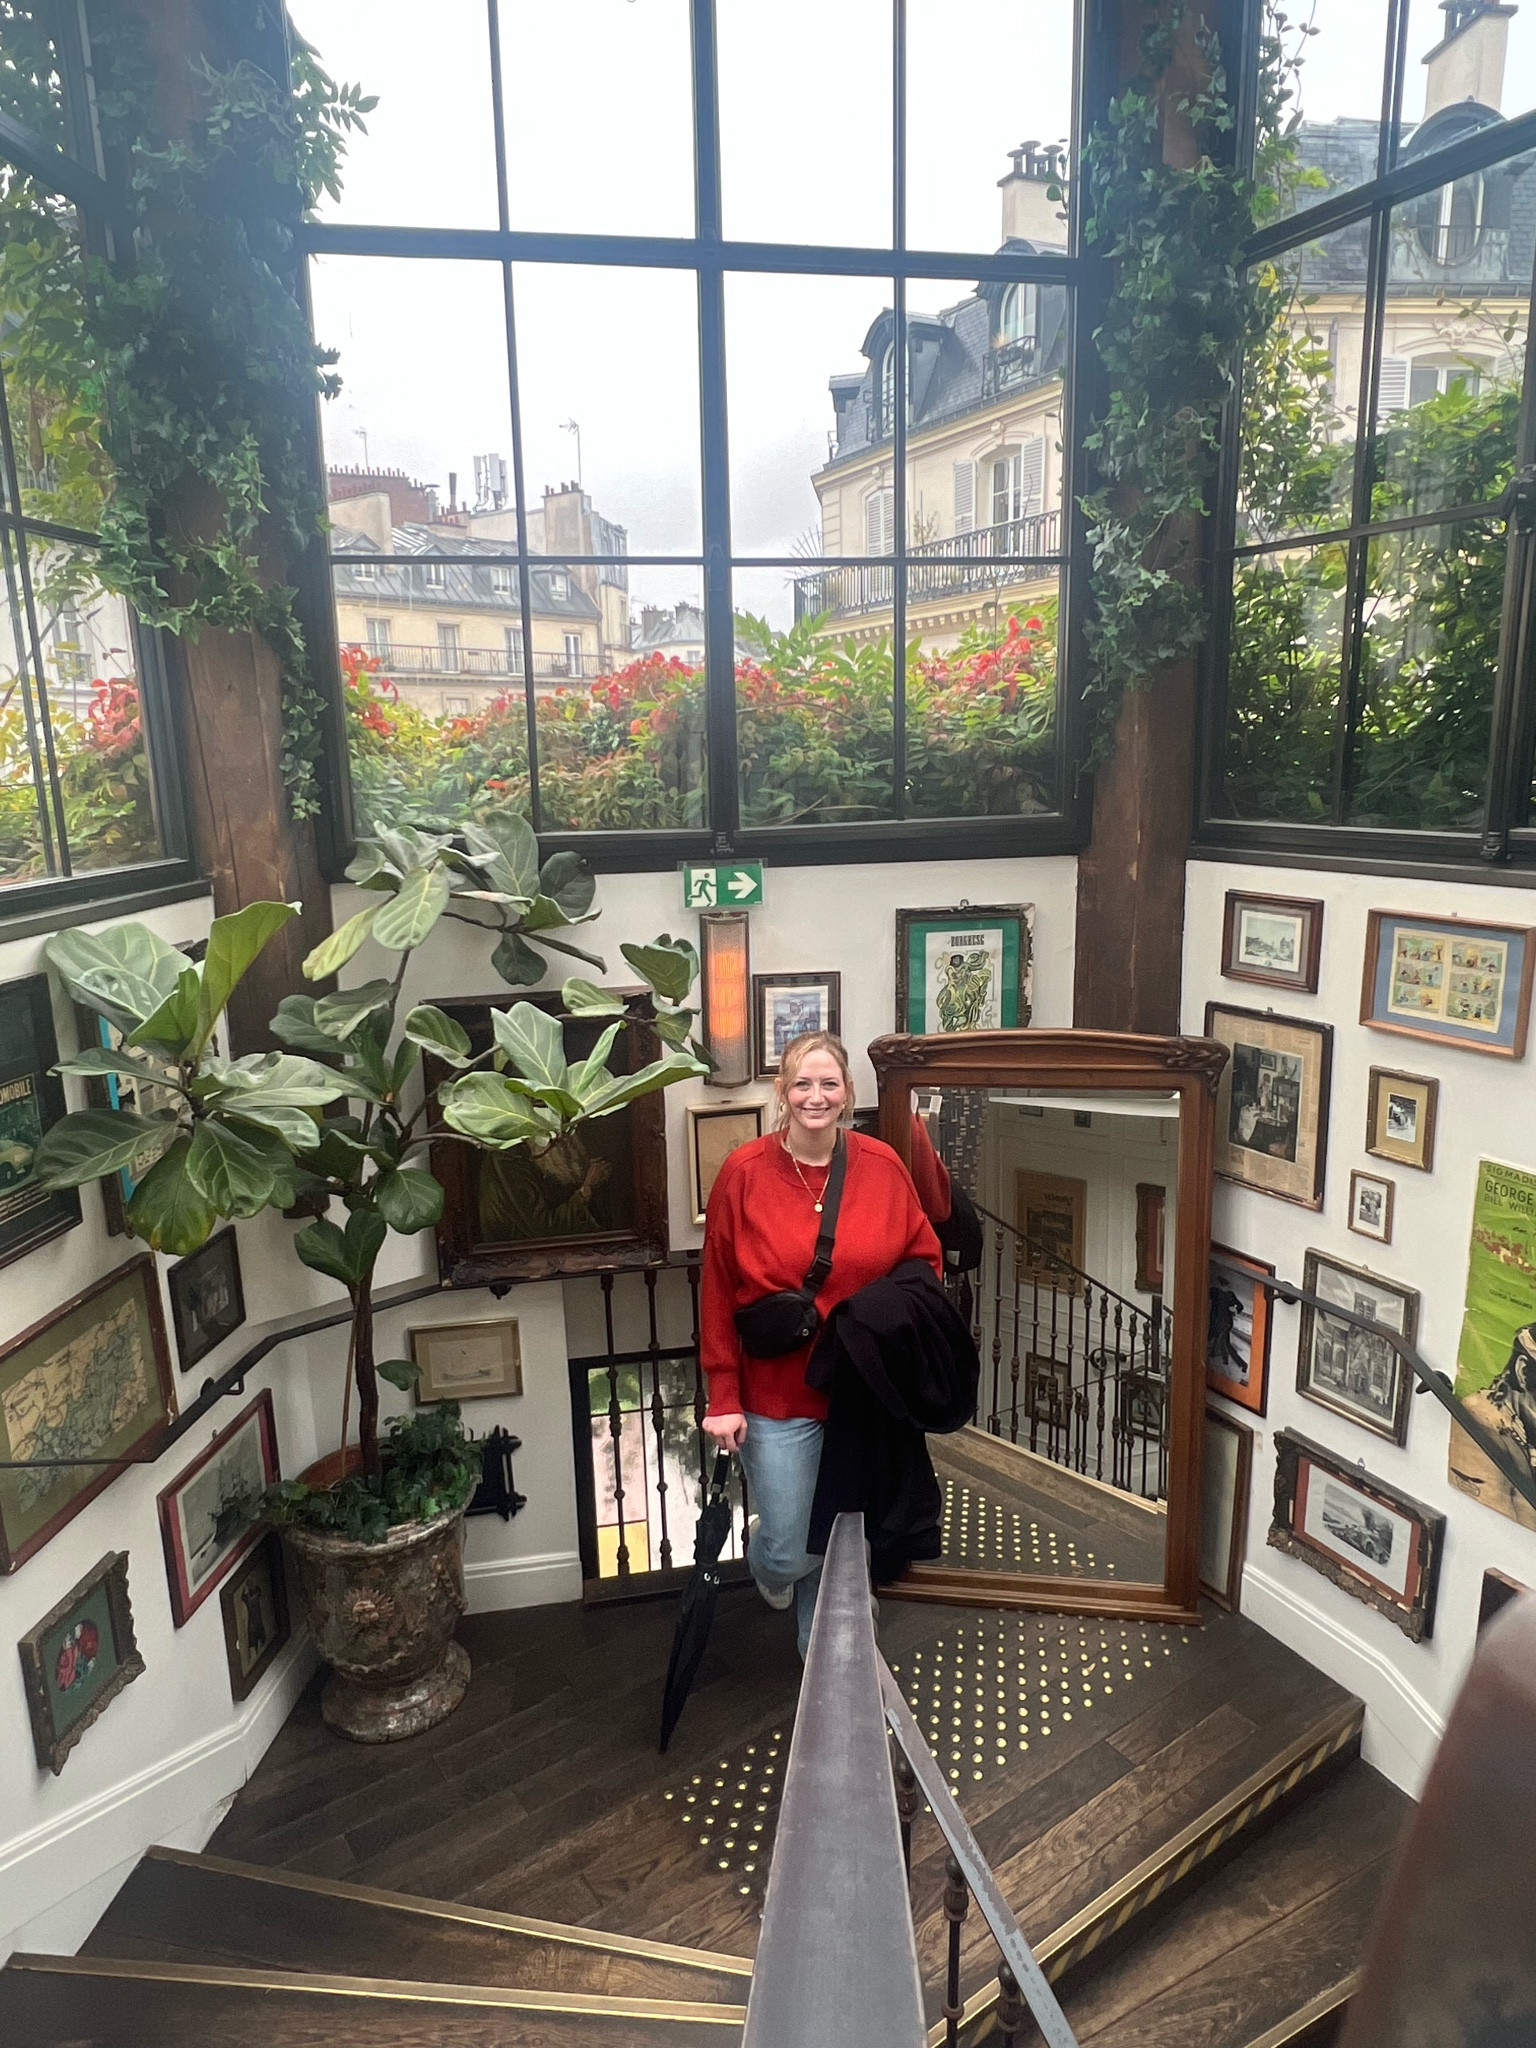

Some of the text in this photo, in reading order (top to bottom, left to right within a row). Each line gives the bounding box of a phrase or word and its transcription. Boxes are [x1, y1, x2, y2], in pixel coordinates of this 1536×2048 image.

[1486, 1164, 1536, 1184] SIGMADI
[1484, 1193, 1536, 1217] BILL WILLI
[1485, 1180, 1534, 1206] GEORGE
